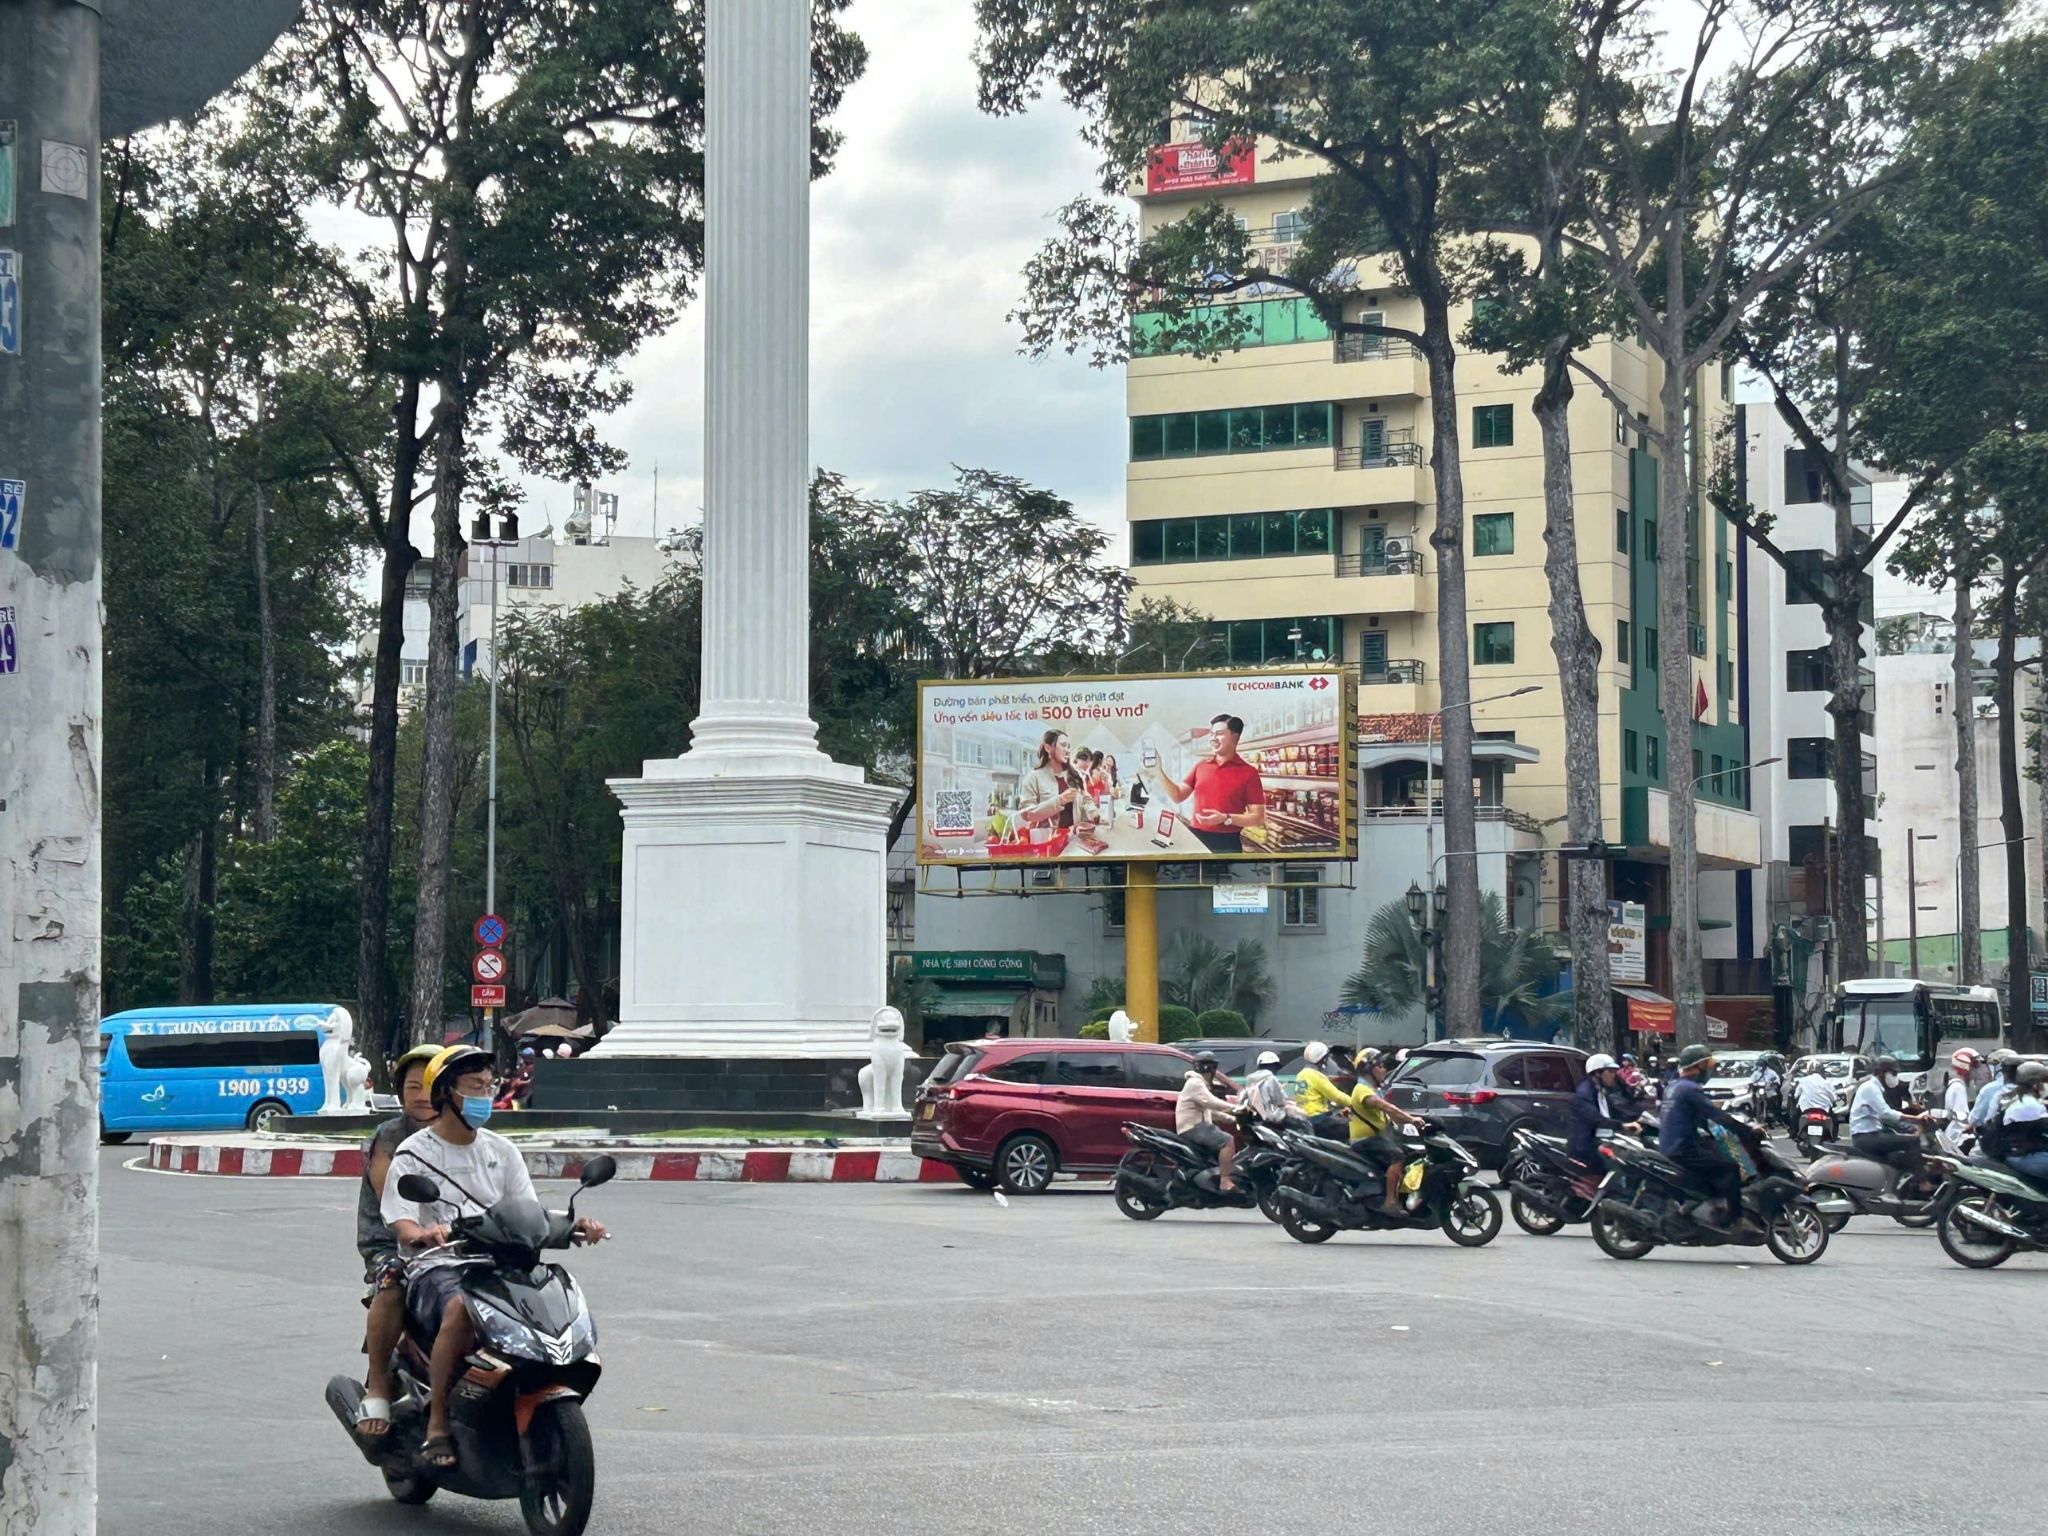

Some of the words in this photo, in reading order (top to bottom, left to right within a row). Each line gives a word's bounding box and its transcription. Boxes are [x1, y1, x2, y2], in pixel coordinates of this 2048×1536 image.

[1226, 680, 1304, 691] TECHCOMBANK
[1041, 705, 1073, 719] 500
[1077, 703, 1112, 721] triệu
[158, 1020, 217, 1035] TRUNG
[218, 1079, 261, 1097] 1900
[267, 1077, 310, 1096] 1939
